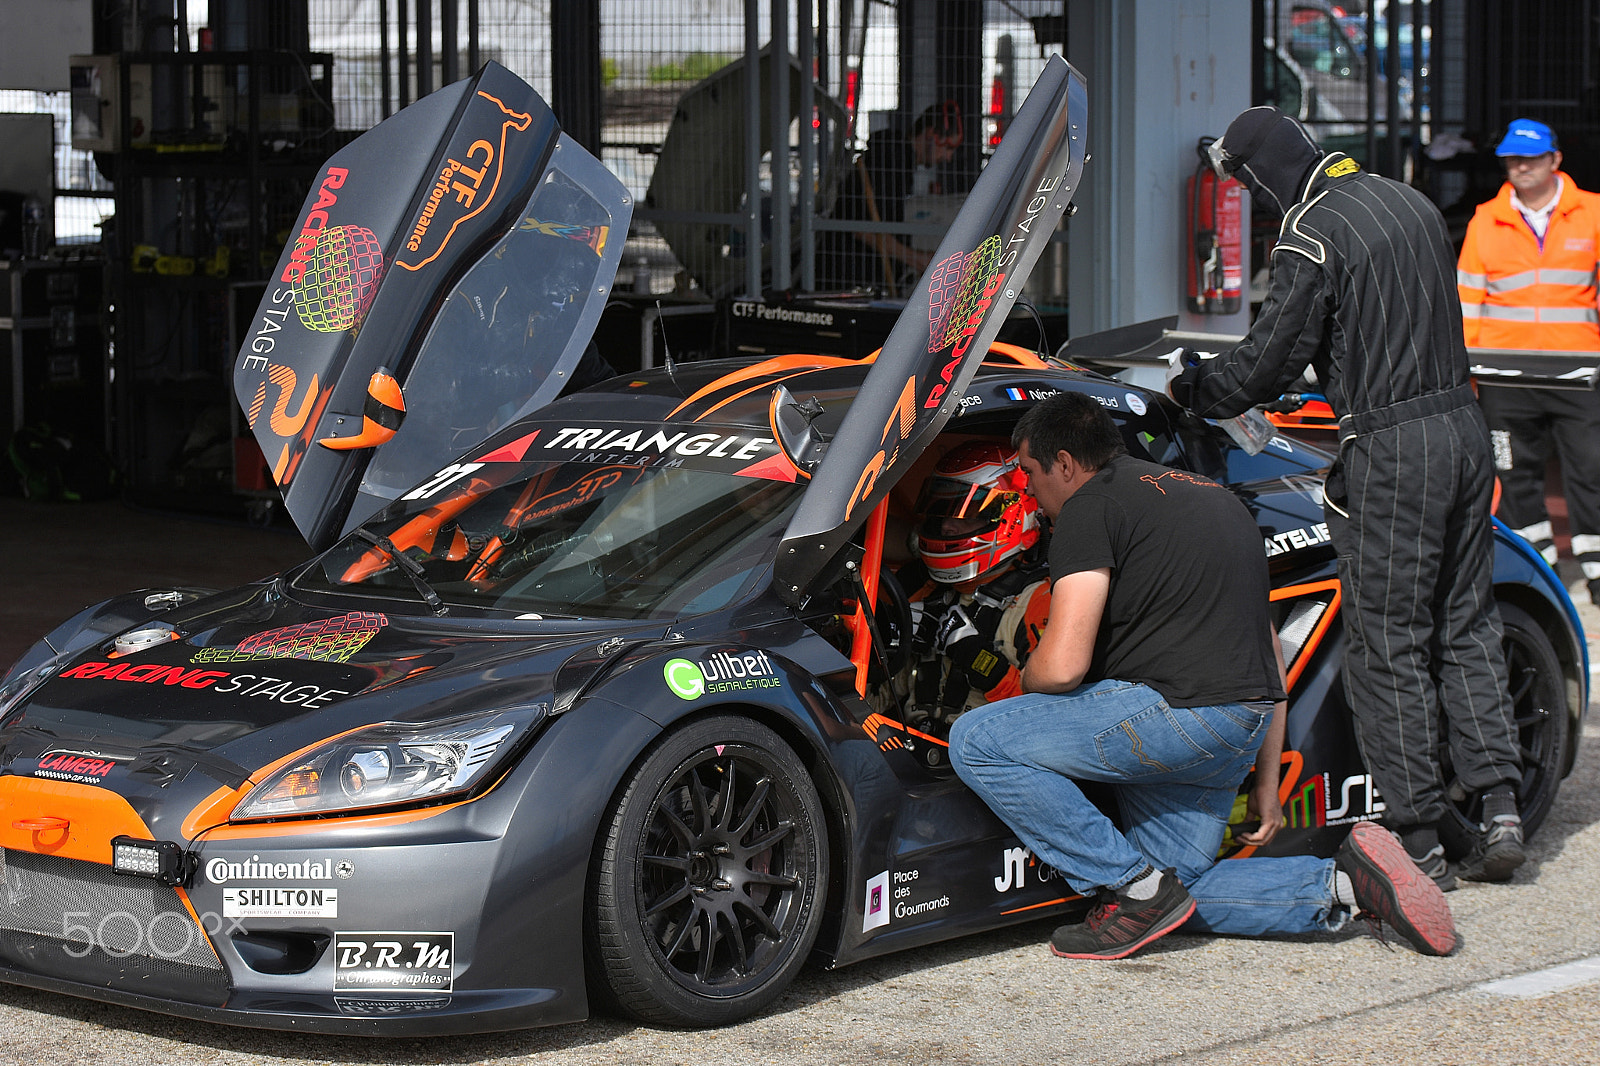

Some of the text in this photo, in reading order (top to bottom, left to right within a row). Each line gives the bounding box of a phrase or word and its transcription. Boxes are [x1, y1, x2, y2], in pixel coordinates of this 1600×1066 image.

[451, 139, 494, 209] CTF
[406, 158, 462, 252] Performance
[242, 166, 349, 372] RACING STAGE
[923, 175, 1059, 409] RACING STAGE
[732, 302, 833, 326] CTF Performance
[545, 427, 774, 460] TRIANGLE
[569, 452, 686, 468] INTERIM
[400, 463, 486, 501] 27
[59, 662, 349, 709] RACING STAGE
[667, 649, 774, 695] Guilbert
[38, 753, 116, 777] LAMERA
[205, 854, 333, 884] Continental
[893, 869, 919, 885] Place
[238, 889, 323, 907] SHILTON
[894, 886, 911, 899] des
[895, 896, 950, 919] Gourmands
[337, 941, 451, 969] B.R.M
